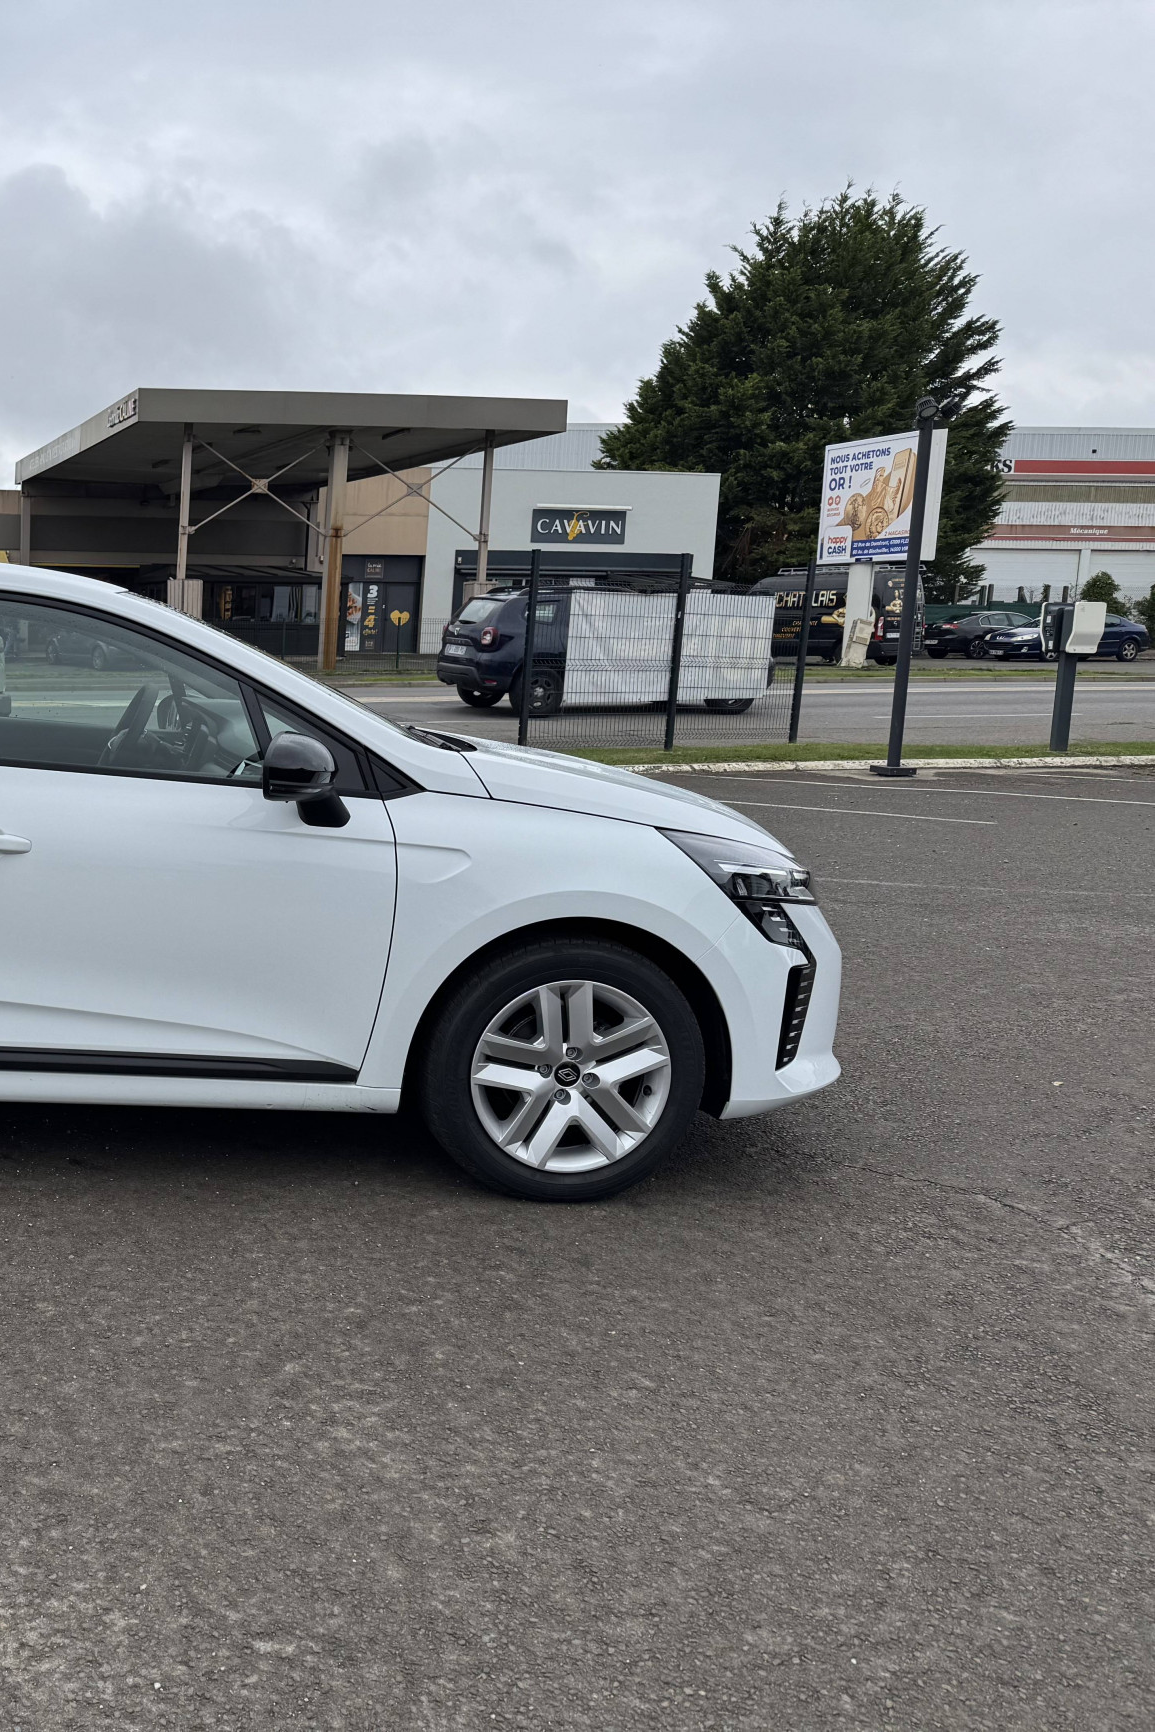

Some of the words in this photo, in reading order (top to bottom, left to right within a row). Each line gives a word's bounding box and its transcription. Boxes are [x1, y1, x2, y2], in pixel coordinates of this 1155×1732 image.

[830, 454, 850, 465] NOUS
[851, 447, 891, 461] ACHETONS
[830, 466, 848, 476] TOUT
[849, 461, 874, 473] VOTRE
[828, 476, 846, 491] OR
[536, 518, 622, 535] CAVAVIN
[827, 535, 849, 545] happy
[827, 545, 847, 555] CASH
[366, 584, 378, 598] 3
[775, 590, 838, 608] CHATLAIS
